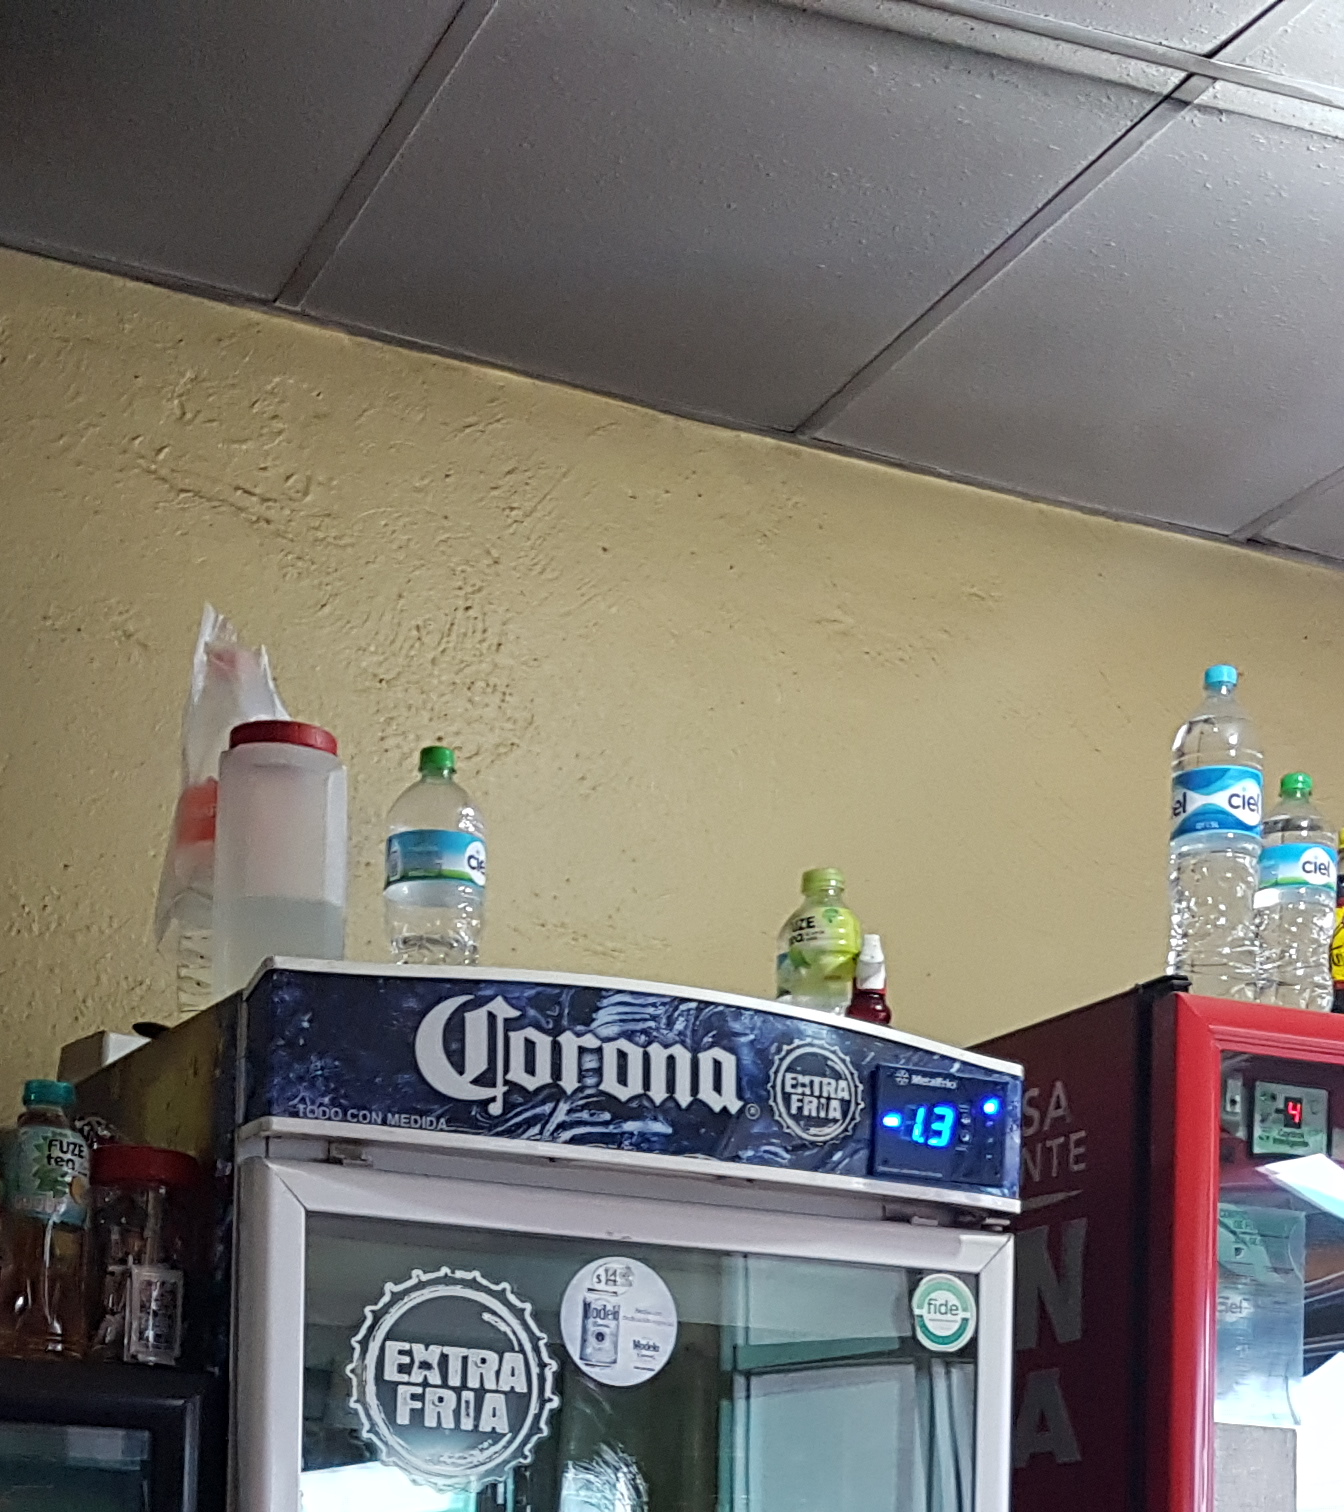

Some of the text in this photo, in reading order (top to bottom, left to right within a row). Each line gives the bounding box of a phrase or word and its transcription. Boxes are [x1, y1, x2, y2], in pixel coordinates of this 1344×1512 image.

[1301, 857, 1331, 878] ciel
[414, 994, 744, 1117] Corona
[783, 1072, 851, 1101] EXTRA
[296, 1105, 448, 1131] TODO CON MEDIDA
[789, 1093, 843, 1120] FRIA
[45, 1153, 76, 1170] tea
[46, 1138, 86, 1159] FUZE
[927, 1298, 960, 1317] fide
[382, 1340, 529, 1394] EXTRA
[395, 1384, 510, 1434] FRIA
